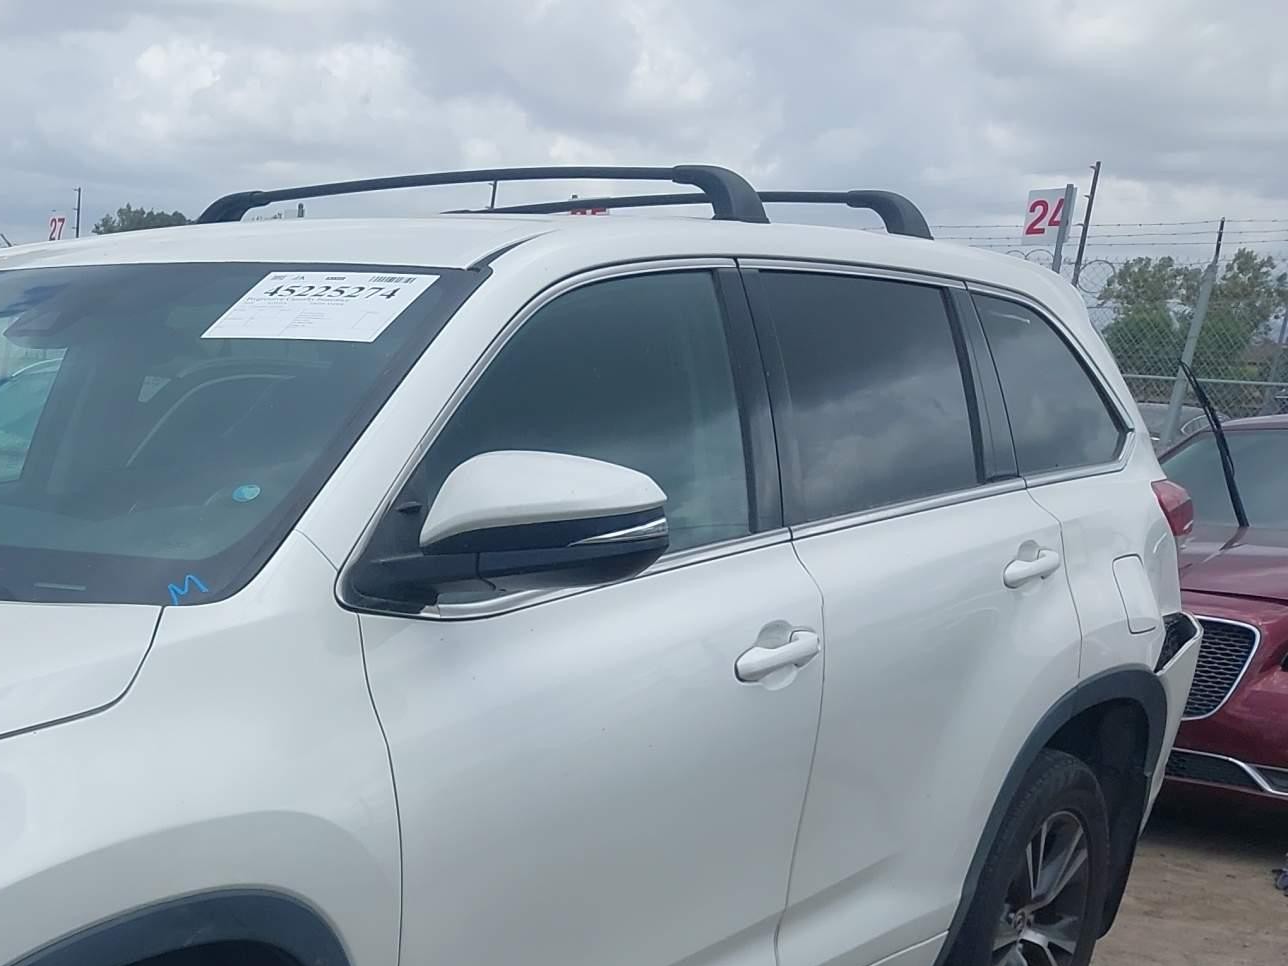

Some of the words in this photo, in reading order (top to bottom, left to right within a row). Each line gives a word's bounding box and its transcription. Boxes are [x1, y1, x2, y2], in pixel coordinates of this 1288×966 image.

[48, 217, 66, 241] 27
[264, 283, 402, 300] 45225274
[167, 574, 209, 606] M
